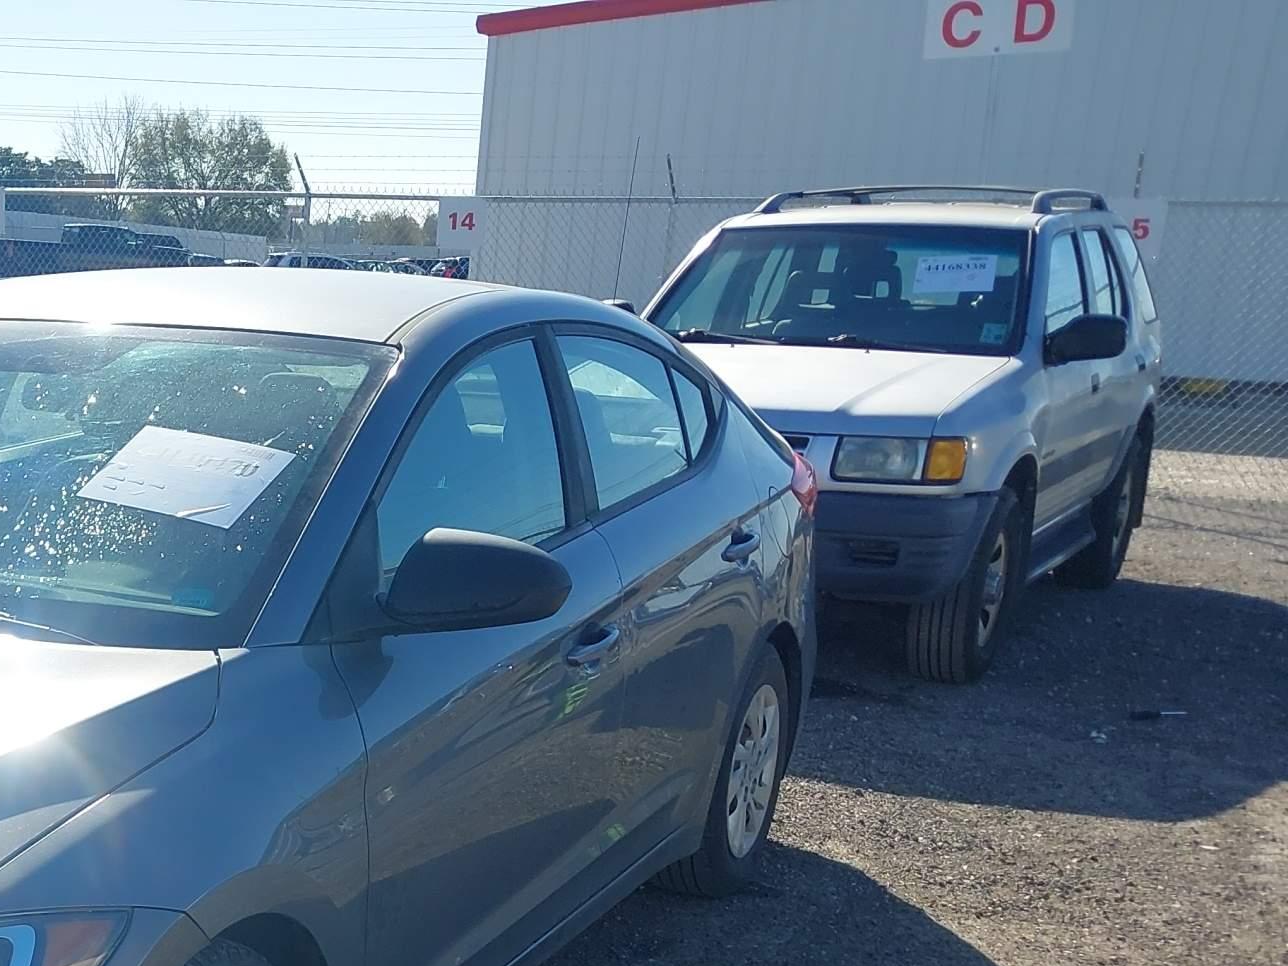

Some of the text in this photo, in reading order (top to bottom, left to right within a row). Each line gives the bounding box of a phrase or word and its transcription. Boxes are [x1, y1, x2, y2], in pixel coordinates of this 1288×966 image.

[942, 0, 1056, 48] C D
[448, 211, 476, 231] 14
[1133, 218, 1150, 240] 5
